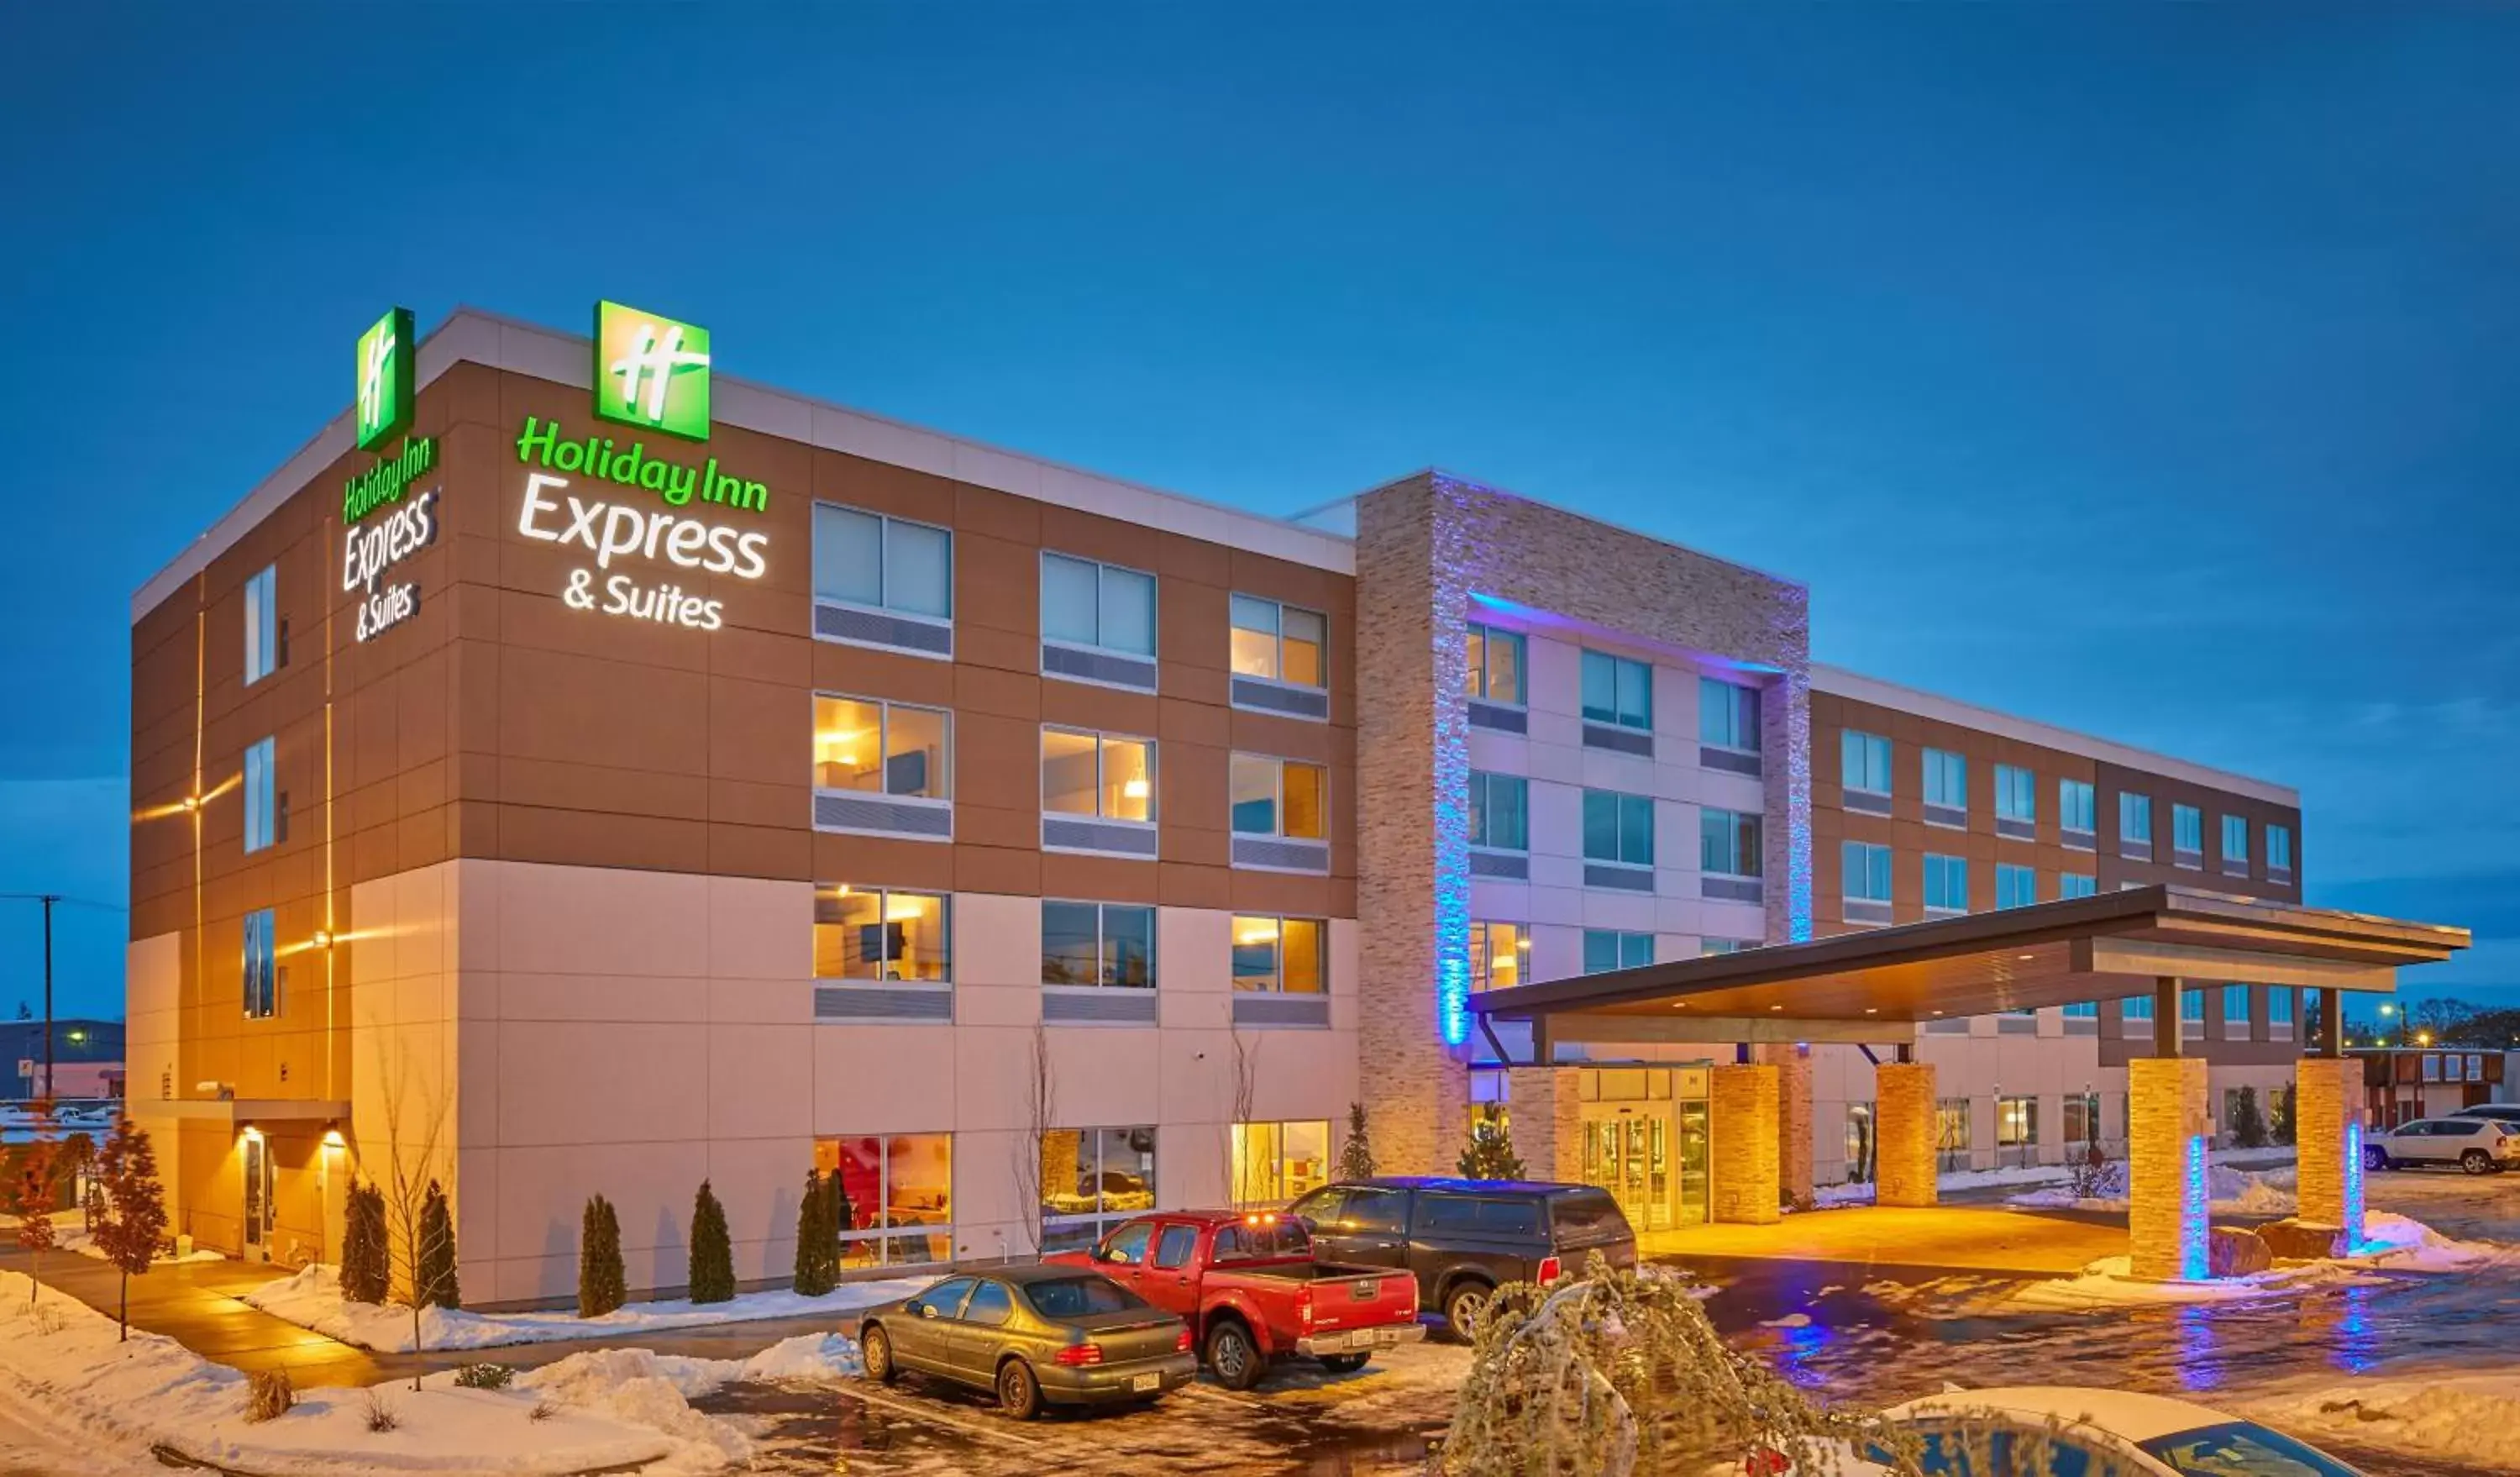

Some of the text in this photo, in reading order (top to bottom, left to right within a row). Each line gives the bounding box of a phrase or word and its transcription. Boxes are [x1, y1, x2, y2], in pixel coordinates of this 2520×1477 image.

[610, 323, 711, 421] H
[343, 435, 430, 524] Holiday Inn
[517, 416, 768, 512] Holiday Inn
[343, 492, 430, 594] Express
[518, 472, 769, 581] Express
[357, 581, 412, 643] & Suites
[563, 568, 724, 631] & Suites
